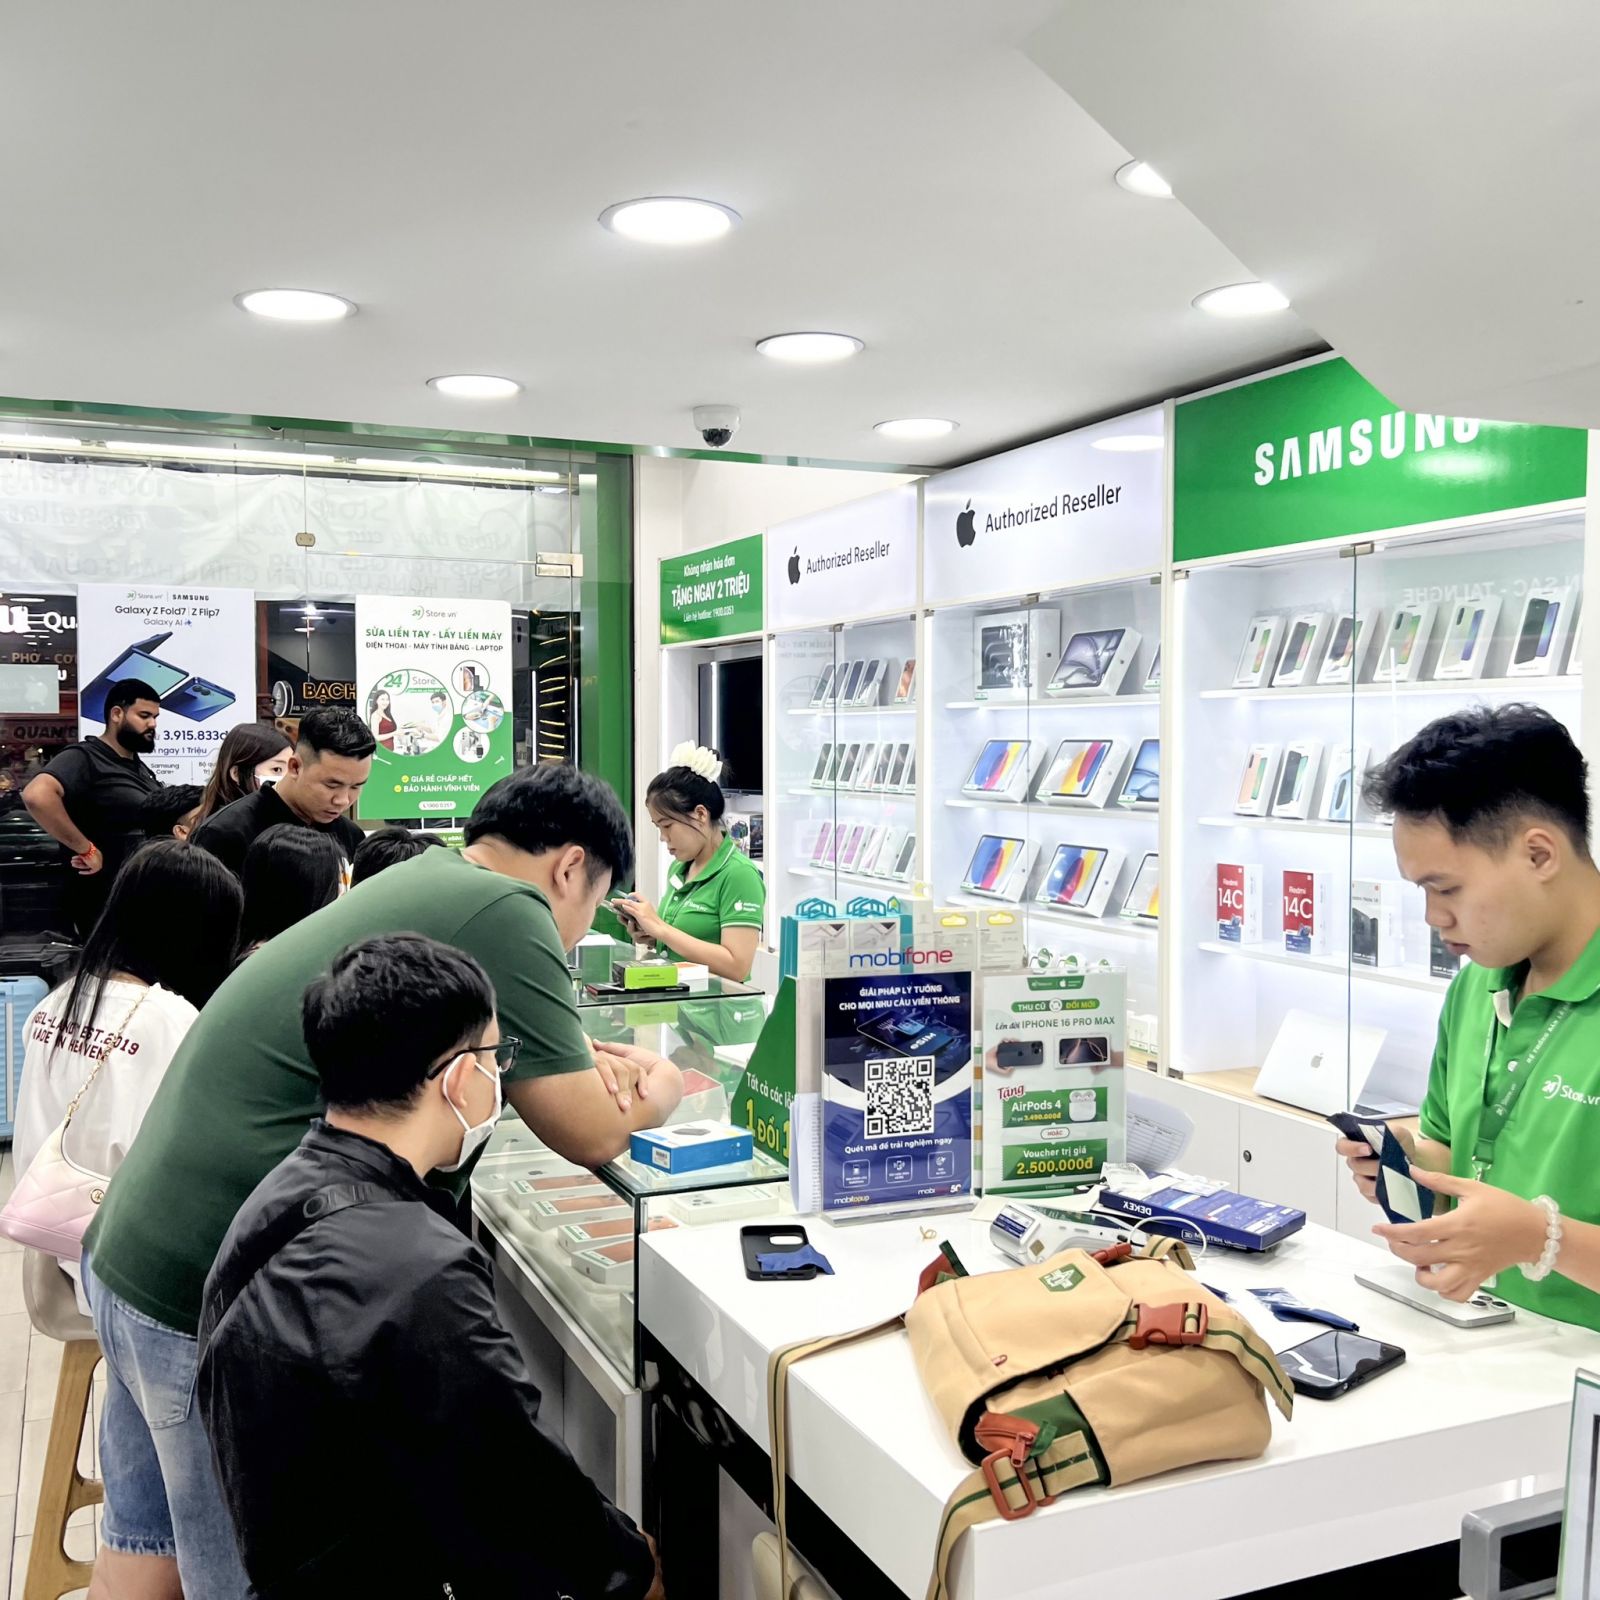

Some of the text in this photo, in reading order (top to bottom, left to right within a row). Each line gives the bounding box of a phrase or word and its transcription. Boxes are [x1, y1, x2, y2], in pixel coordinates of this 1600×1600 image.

[985, 483, 1122, 533] Authorized Reseller
[806, 540, 890, 574] Authorized Reseller
[672, 570, 750, 610] TẶNG NGAY 2 TRIỆU
[115, 605, 220, 618] Galaxy Z Fold7 Z Flip7
[43, 611, 77, 634] Qu
[144, 618, 173, 627] Galaxy
[413, 630, 430, 638] TAY
[151, 762, 179, 770] Samsung
[1289, 886, 1306, 894] Redmi
[1218, 888, 1243, 909] 14C
[1284, 896, 1312, 918] 14C
[849, 948, 953, 967] mobifone
[839, 1002, 856, 1010] CHO
[875, 1000, 892, 1009] NHU
[1018, 1003, 1033, 1011] THU
[1022, 1019, 1058, 1029] IPHONE
[1061, 1019, 1071, 1027] 16
[1073, 1018, 1092, 1026] PRO
[1094, 1016, 1115, 1025] MAX
[910, 1032, 937, 1050] eSIM
[746, 1072, 758, 1092] Tất
[770, 1086, 783, 1105] các
[1011, 1100, 1061, 1112] AirPods 4
[845, 1144, 863, 1153] Quét
[934, 1137, 953, 1145] ngay
[1023, 1149, 1058, 1158] Voucher
[1073, 1144, 1086, 1155] giá
[1016, 1157, 1093, 1174] 2.500.000đ
